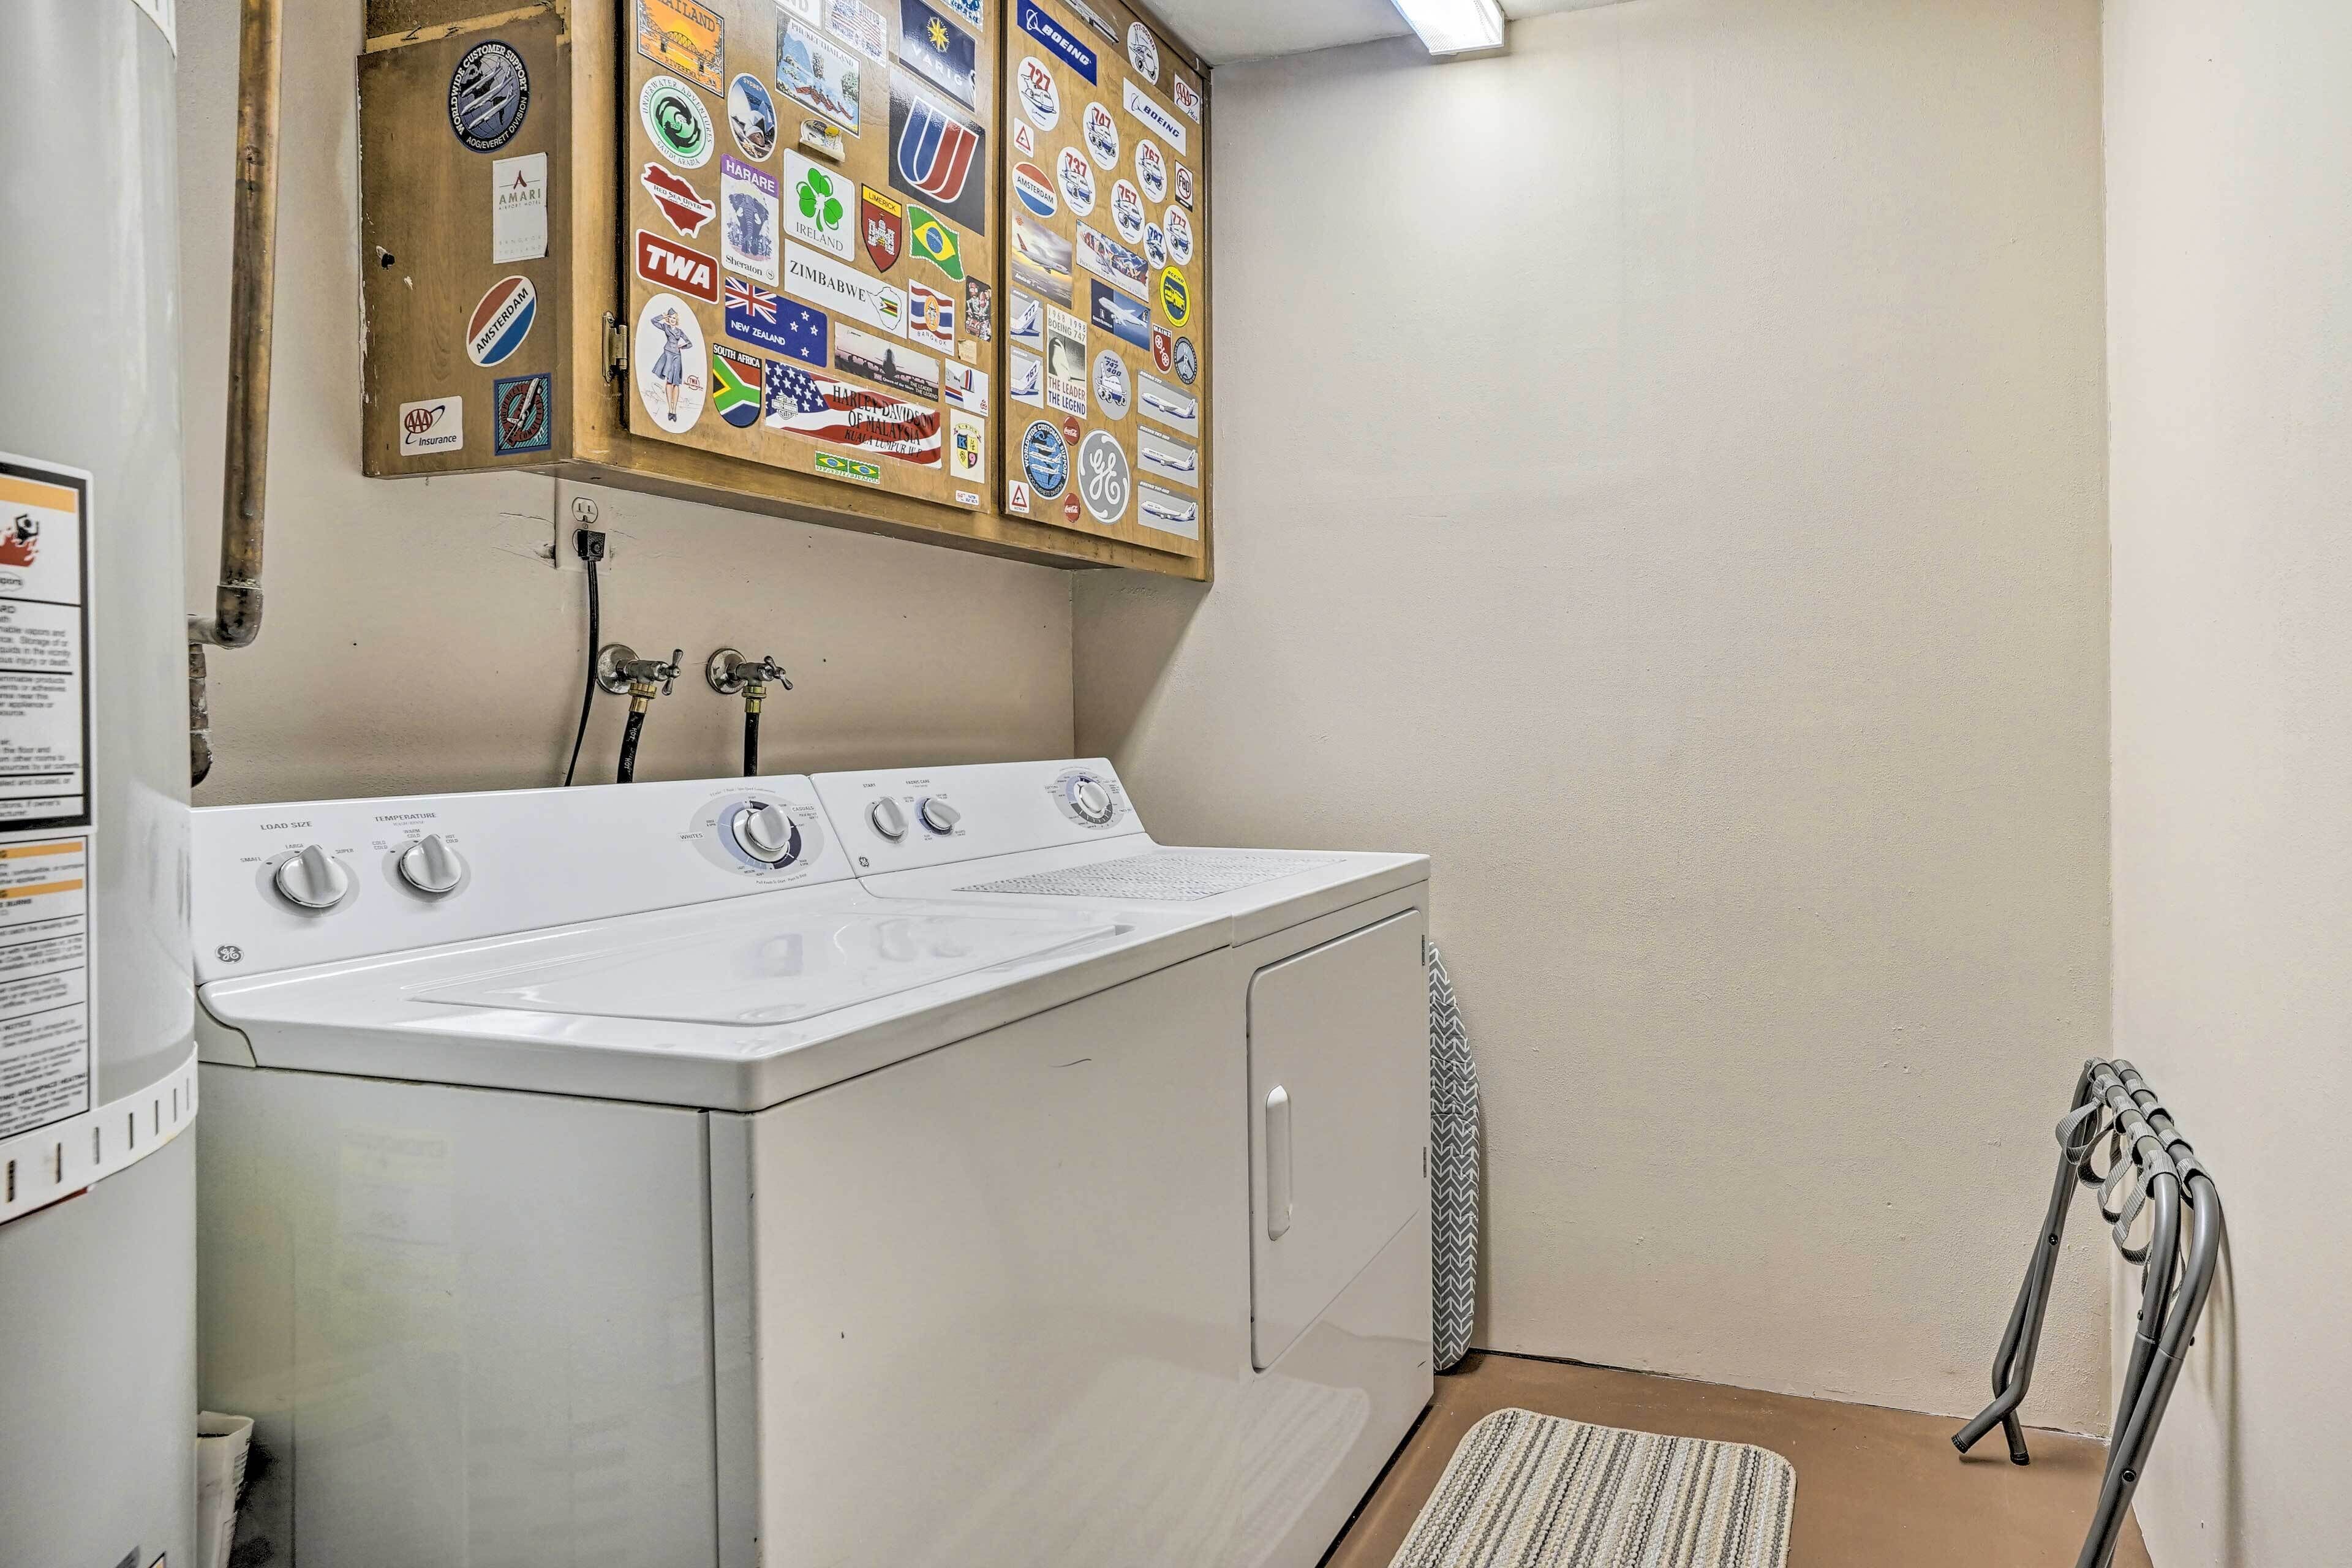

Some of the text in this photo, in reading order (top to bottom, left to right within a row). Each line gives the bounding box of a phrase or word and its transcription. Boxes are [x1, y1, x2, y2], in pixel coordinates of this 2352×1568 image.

[661, 0, 715, 32] AILAND
[791, 23, 818, 45] PHUKET
[821, 39, 854, 67] THAILAND
[1041, 24, 1090, 66] BOEING
[911, 43, 963, 86] VARIG
[1028, 62, 1050, 91] 727
[451, 44, 527, 135] WORLDWIDE CUSTOMER SUPPORT
[742, 78, 763, 92] SYDNEY
[1177, 83, 1190, 105] AAA
[466, 96, 527, 149] AOG/EVERETT DIVISION
[643, 79, 714, 143] UNDERWATER ADVENTURES
[1094, 107, 1111, 129] 747
[1144, 106, 1180, 138] BOEING
[656, 141, 701, 167] SAUDI ARABIA
[1066, 152, 1087, 177] 737
[1144, 144, 1159, 164] 767
[726, 159, 775, 194] HARARE
[499, 188, 541, 205] AMARI
[654, 185, 667, 195] RED
[669, 192, 682, 202] SEA
[682, 198, 702, 210] DIVER
[868, 192, 897, 213] LIMERICK
[1017, 176, 1054, 204] AMSTERDAM
[1118, 184, 1137, 205] 757
[1171, 210, 1186, 228] 777
[796, 221, 843, 252] IRELAND
[1148, 225, 1163, 241] 787
[646, 244, 710, 290] TWA
[725, 254, 763, 276] Sheraton
[790, 260, 866, 303] ZIMBABWE
[475, 287, 529, 355] AMSTERDAM
[1024, 304, 1036, 321] 777
[1048, 307, 1065, 322] 1968
[1069, 317, 1087, 333] 1998
[731, 319, 786, 346] NEW ZEALAND
[917, 331, 947, 346] BANGKOK
[1048, 317, 1086, 342] BOEING 747
[1154, 325, 1172, 337] MAINZ
[713, 344, 761, 368] SOUTH AFRICA
[1106, 360, 1118, 369] 747
[1026, 364, 1038, 383] 767
[1107, 368, 1121, 377] 400
[1049, 375, 1086, 402] THE LEADER
[1048, 390, 1086, 415] THE LEGEND
[406, 409, 431, 434] AAA
[848, 410, 921, 446] OF MALAYSIA
[418, 433, 457, 447] Insurance
[844, 429, 873, 446] KUALA
[875, 439, 908, 455] LUMPUR
[957, 435, 967, 449] K
[1023, 425, 1038, 467] WORLDWIDE
[1037, 424, 1062, 446] CUSTOMER
[260, 823, 288, 831] LOAD
[375, 812, 437, 823] TEMPERATURE
